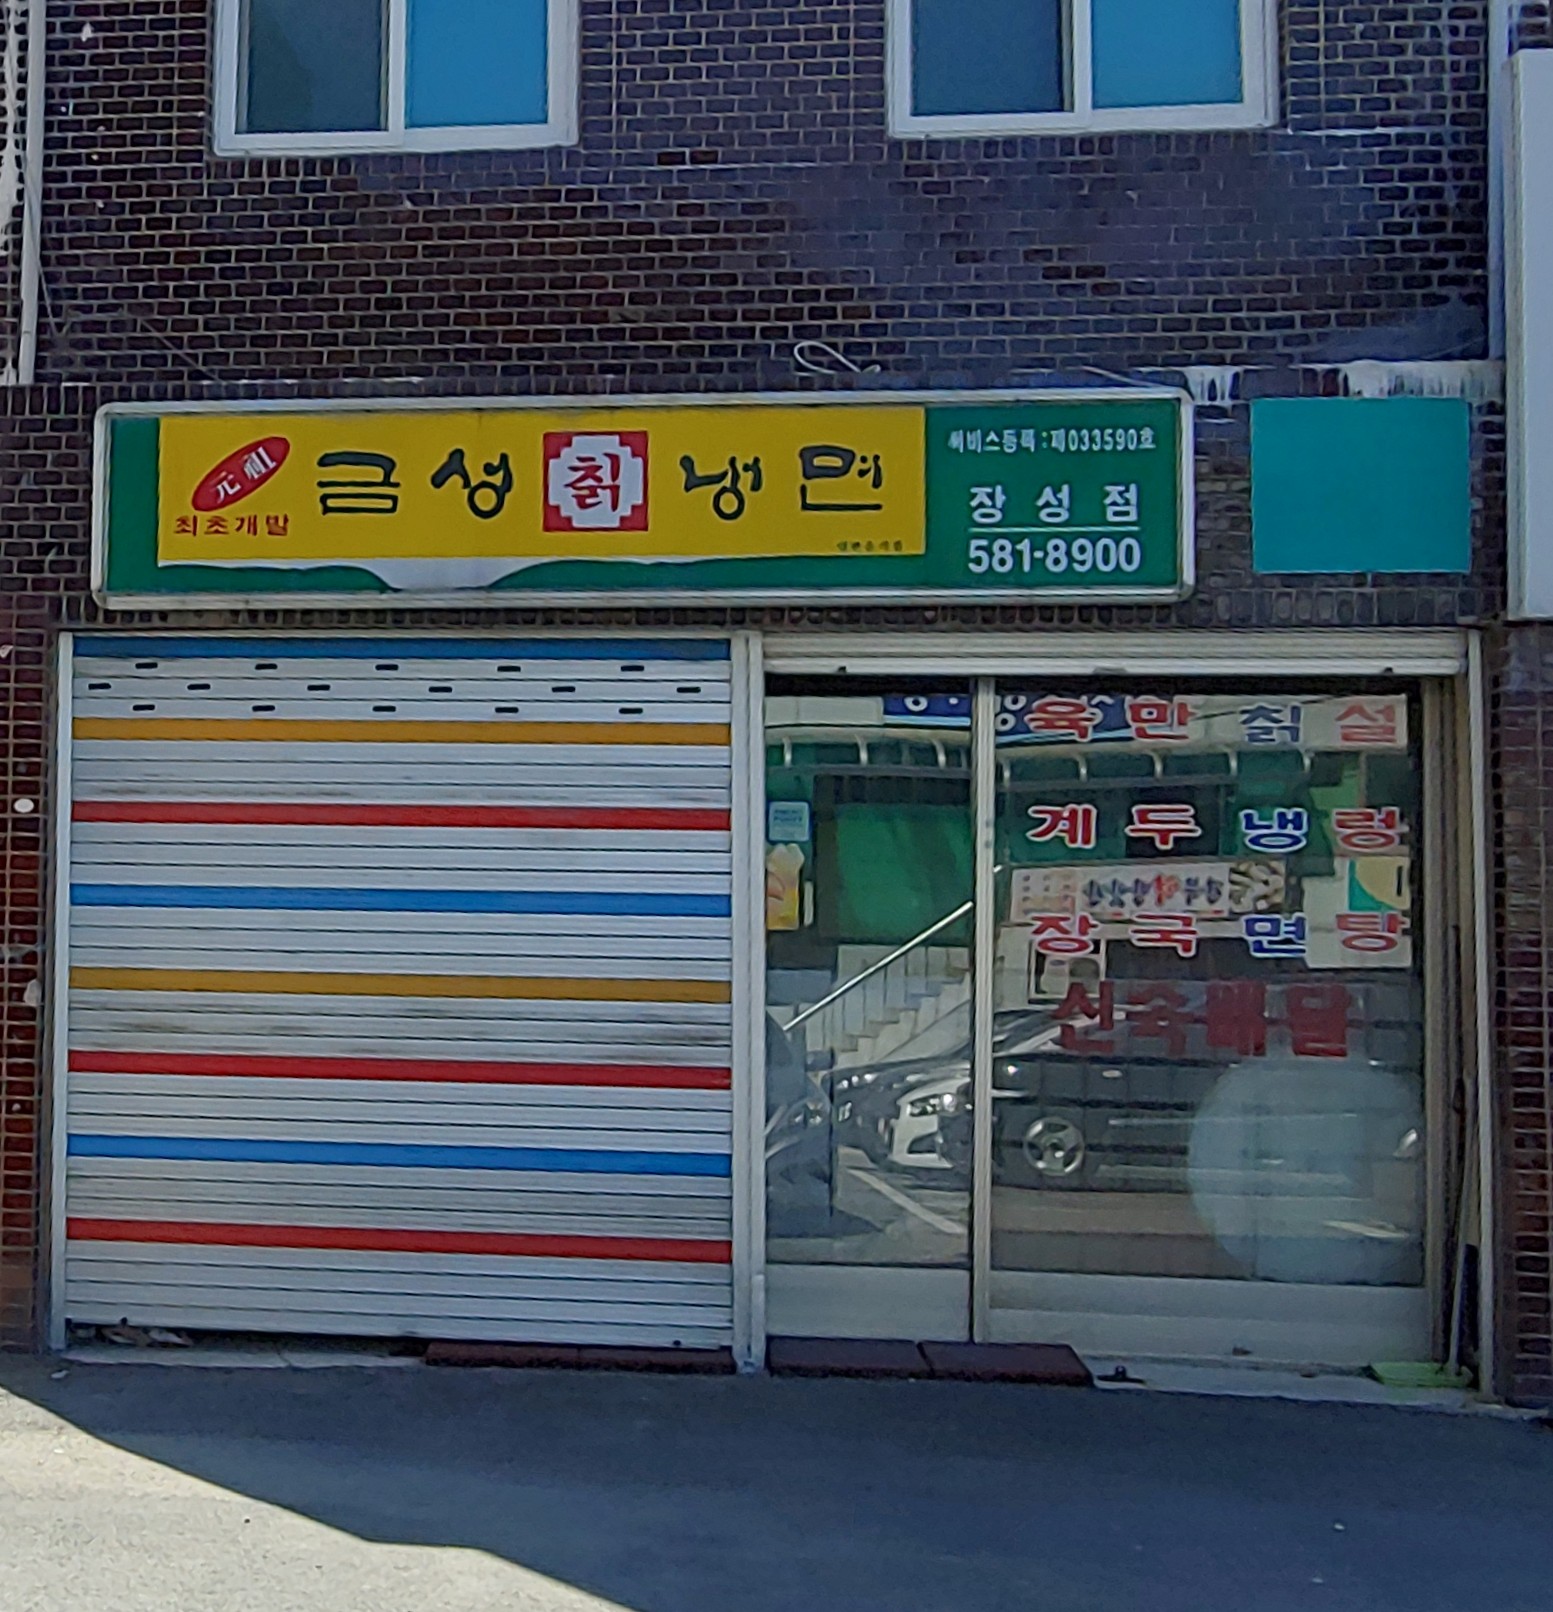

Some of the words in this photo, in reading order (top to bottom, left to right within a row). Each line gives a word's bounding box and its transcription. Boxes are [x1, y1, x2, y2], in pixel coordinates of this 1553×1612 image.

[678, 444, 884, 521] 냉면
[969, 482, 1140, 524] 장성점
[172, 512, 291, 538] 최초개발
[968, 537, 1142, 574] 581-8900
